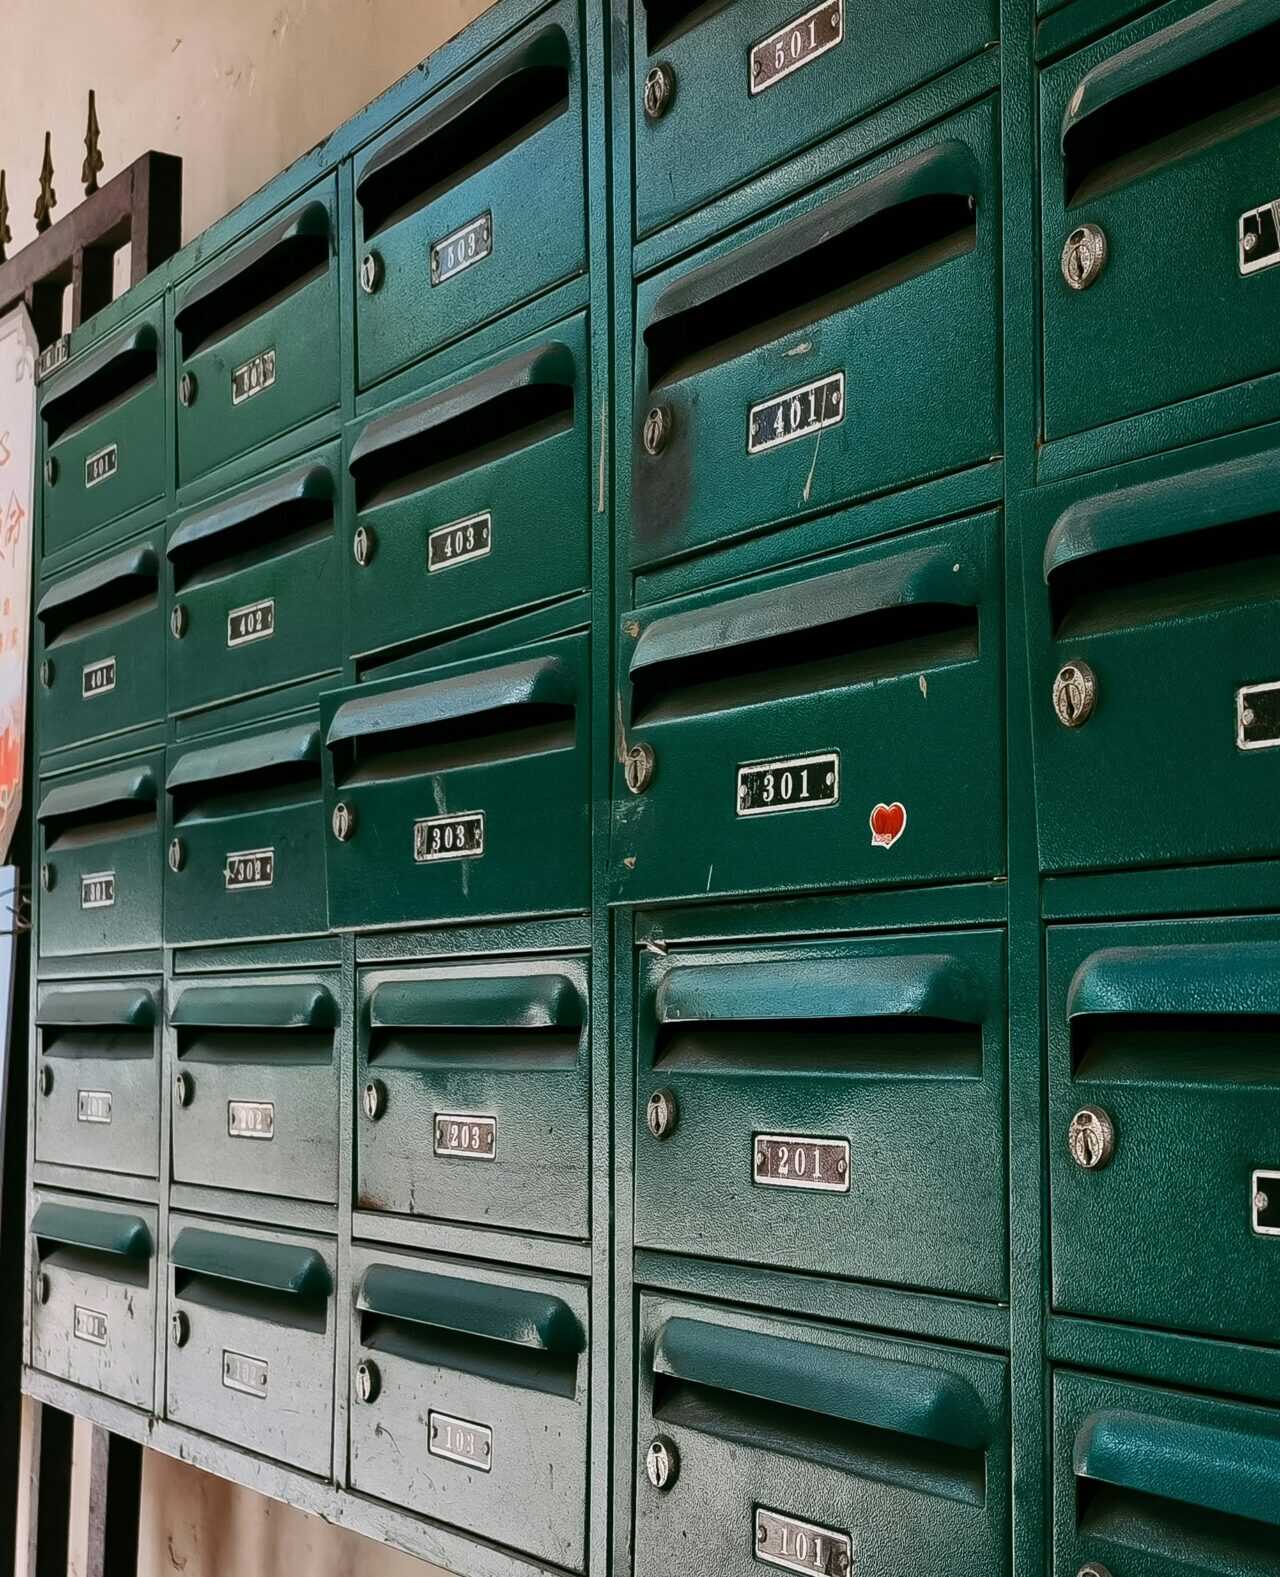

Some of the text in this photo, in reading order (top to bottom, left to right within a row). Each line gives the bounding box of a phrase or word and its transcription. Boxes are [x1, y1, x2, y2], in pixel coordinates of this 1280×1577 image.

[776, 19, 818, 69] 501
[773, 390, 817, 437] 401
[445, 527, 474, 557] 403
[240, 611, 262, 635] 402
[763, 770, 811, 801] 301
[431, 825, 465, 851] 303
[449, 1124, 480, 1150] 203
[778, 1147, 823, 1178] 201
[779, 1528, 822, 1567] 101
